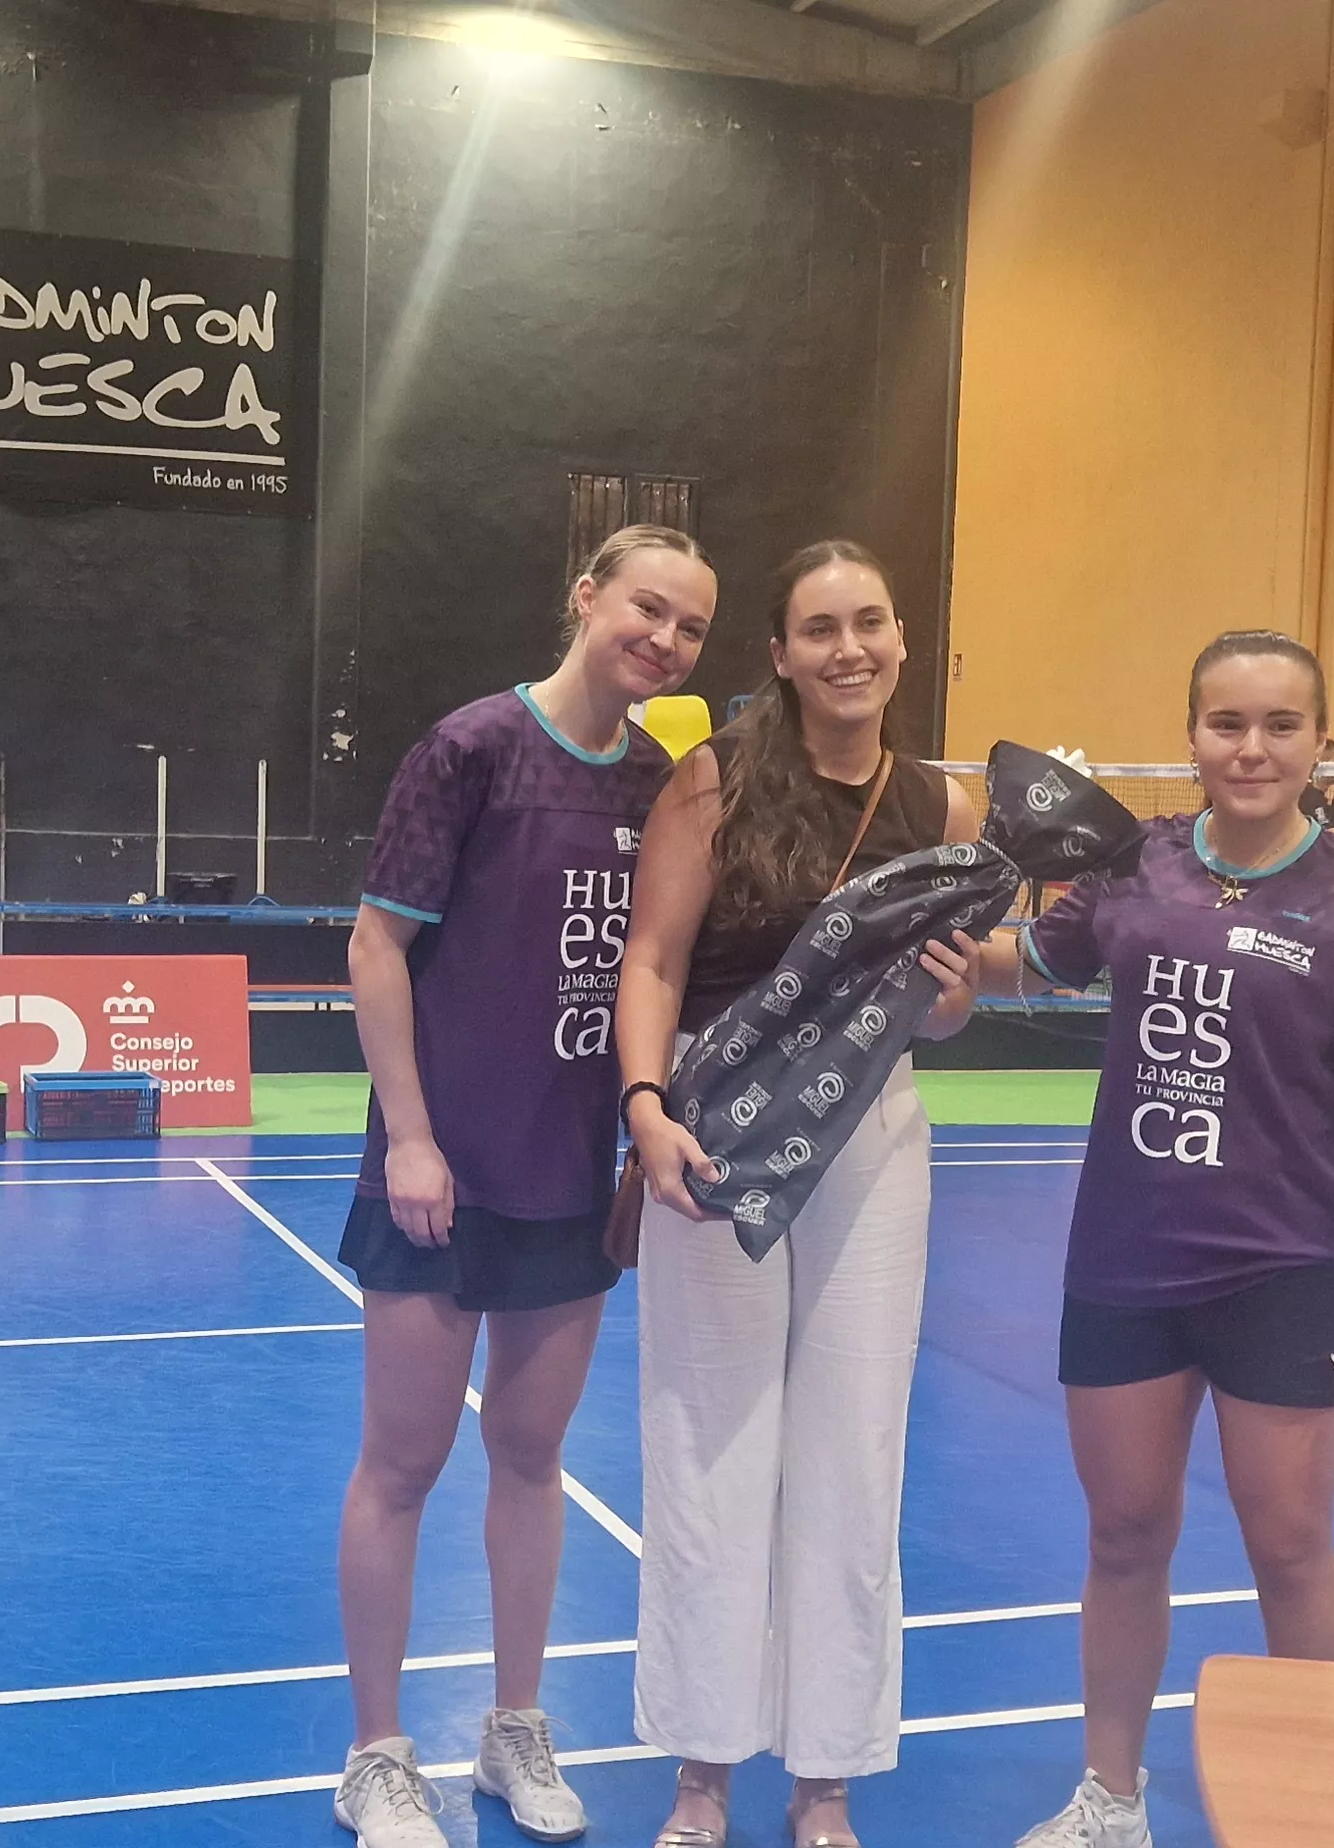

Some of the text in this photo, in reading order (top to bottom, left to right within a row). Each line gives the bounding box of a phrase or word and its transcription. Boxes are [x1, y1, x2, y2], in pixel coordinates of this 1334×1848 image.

[152, 466, 289, 494] Fundado en 1995
[562, 869, 632, 910] Hu
[559, 913, 629, 969] es
[812, 929, 842, 952] MIGUEL
[1254, 941, 1312, 970] HUESCA
[1142, 953, 1236, 1011] Hu
[110, 1032, 194, 1054] Consejo
[847, 1020, 876, 1047] MIGUEL
[1138, 1002, 1232, 1069] es
[112, 1053, 200, 1073] Superior
[157, 1076, 236, 1097] eportes
[802, 1085, 831, 1114] MIGUEL
[734, 1204, 766, 1219] MIGUEL
